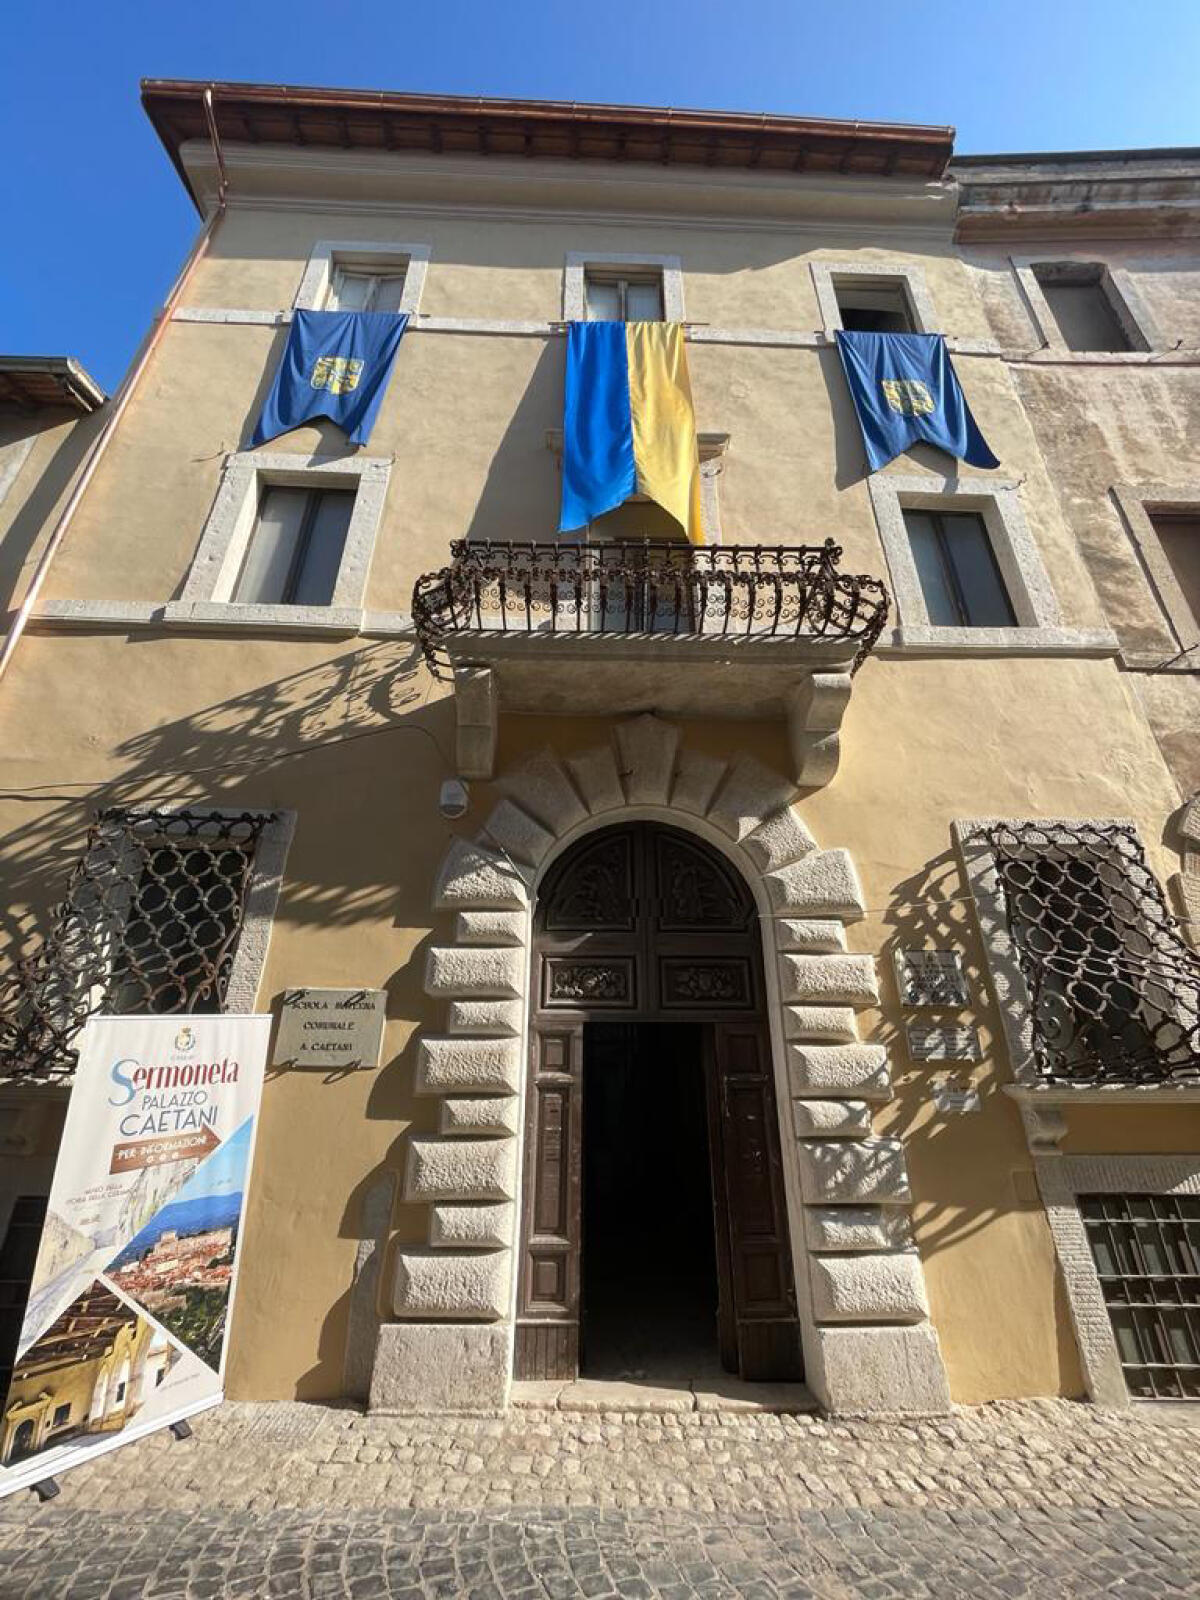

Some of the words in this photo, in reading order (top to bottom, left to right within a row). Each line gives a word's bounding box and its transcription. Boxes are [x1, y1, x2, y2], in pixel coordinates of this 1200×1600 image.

[108, 1057, 239, 1107] Sermoneta
[141, 1090, 208, 1111] PALAZZO
[119, 1105, 218, 1137] CAETANI
